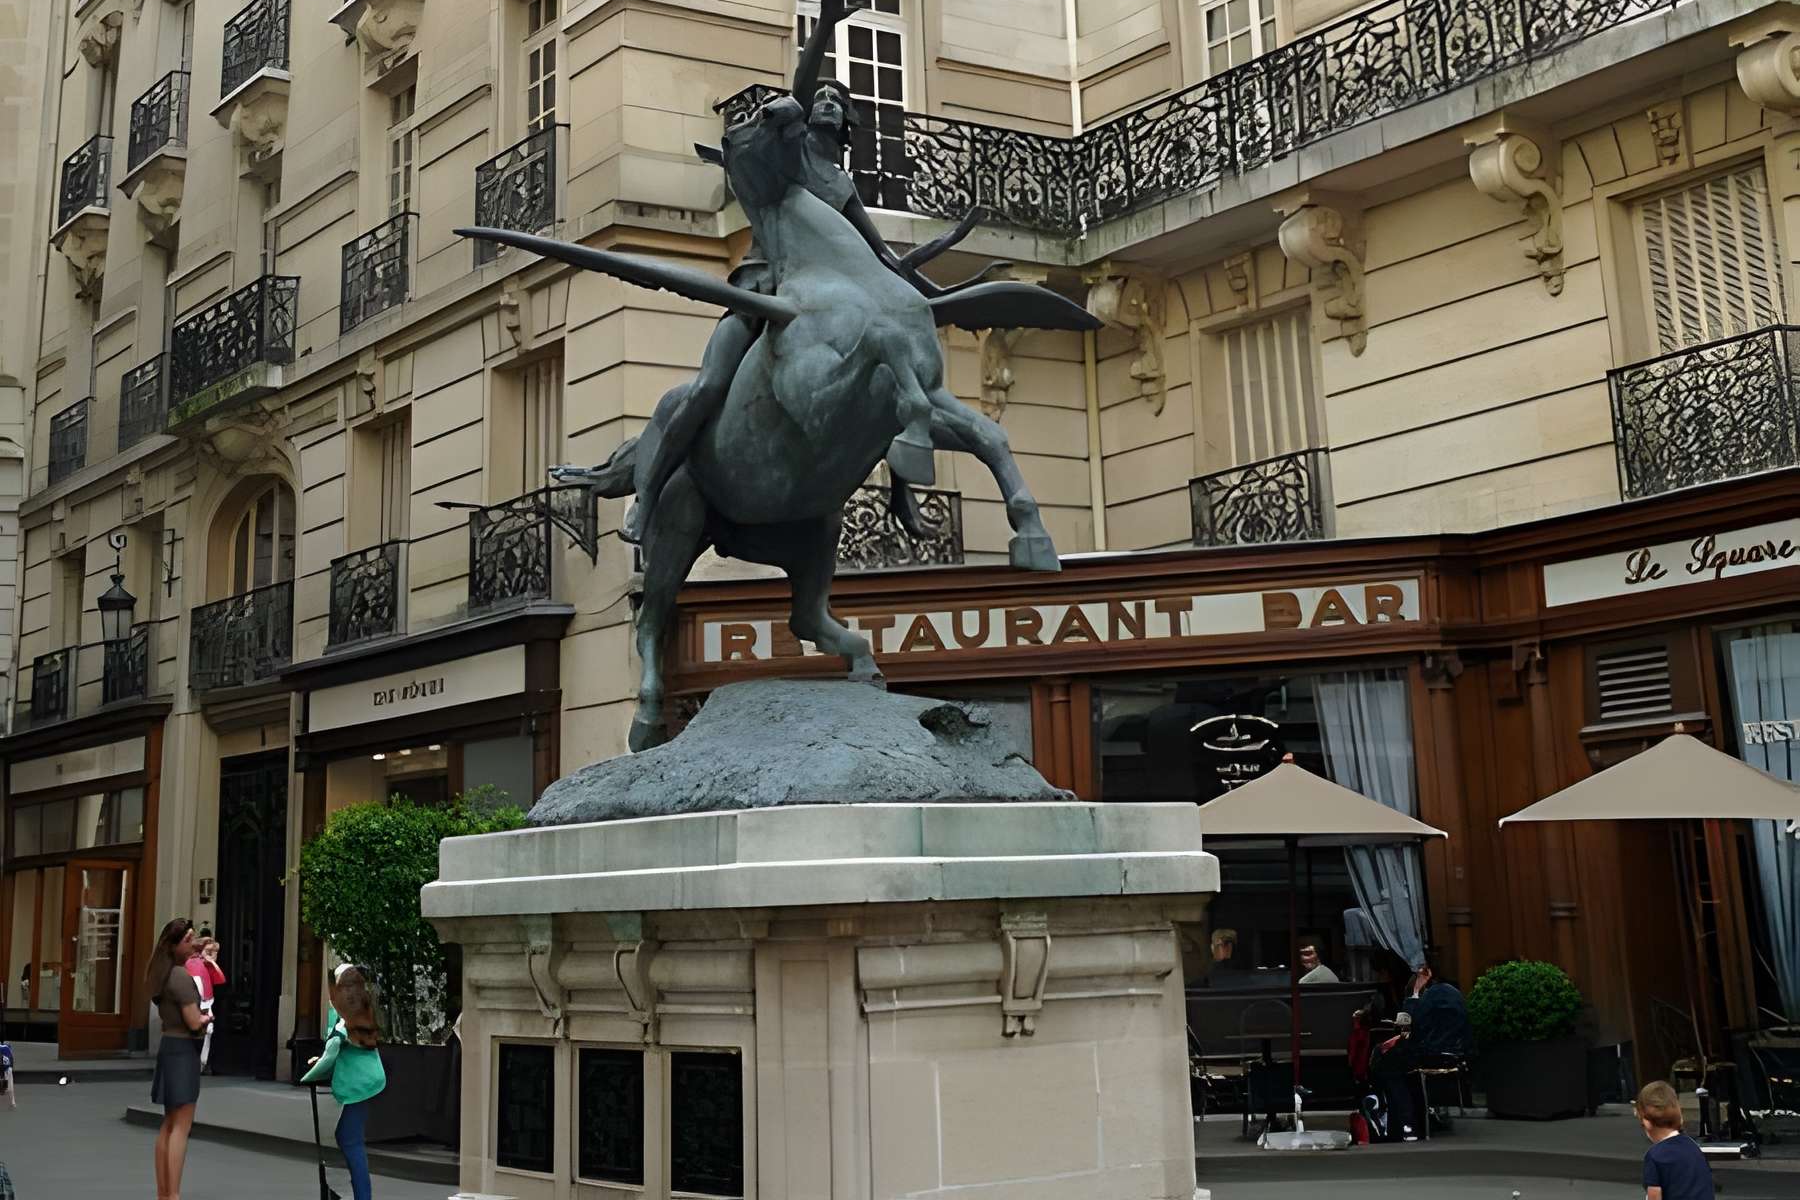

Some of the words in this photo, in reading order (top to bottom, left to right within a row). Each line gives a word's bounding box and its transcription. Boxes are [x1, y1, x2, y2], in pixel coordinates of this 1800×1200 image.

[1625, 548, 1668, 585] Le
[1685, 534, 1798, 580] Square
[720, 599, 1193, 662] RETAURANT
[1262, 583, 1406, 629] BAR
